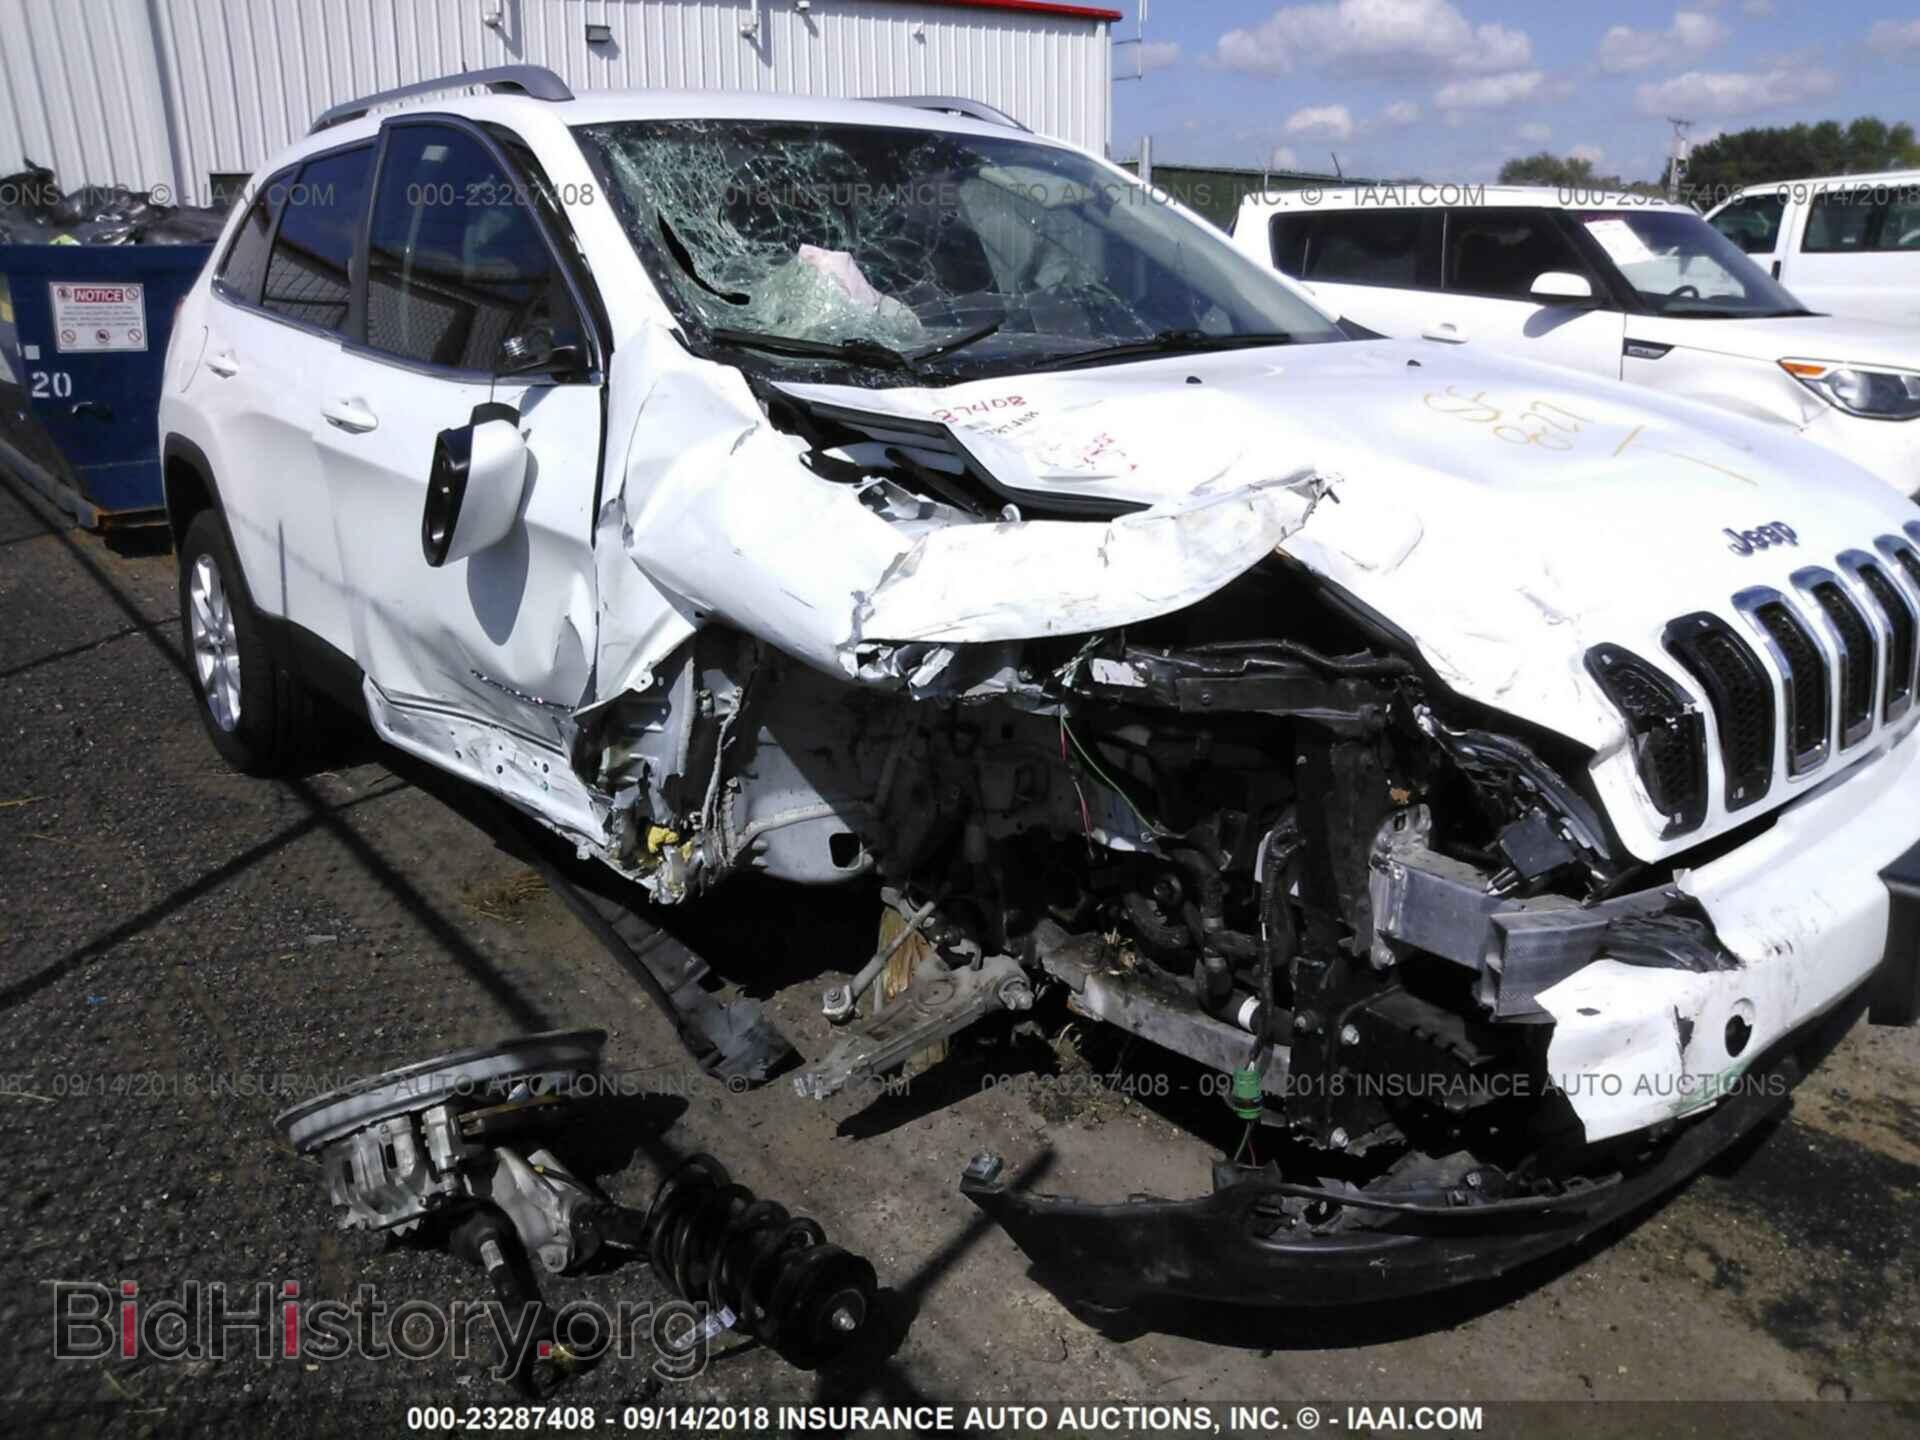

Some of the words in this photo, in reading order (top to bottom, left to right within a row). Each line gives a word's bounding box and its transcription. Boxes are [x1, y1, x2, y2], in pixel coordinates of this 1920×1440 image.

[75, 289, 122, 302] NOTICE
[32, 371, 72, 398] 20
[1722, 520, 1799, 557] Jeep
